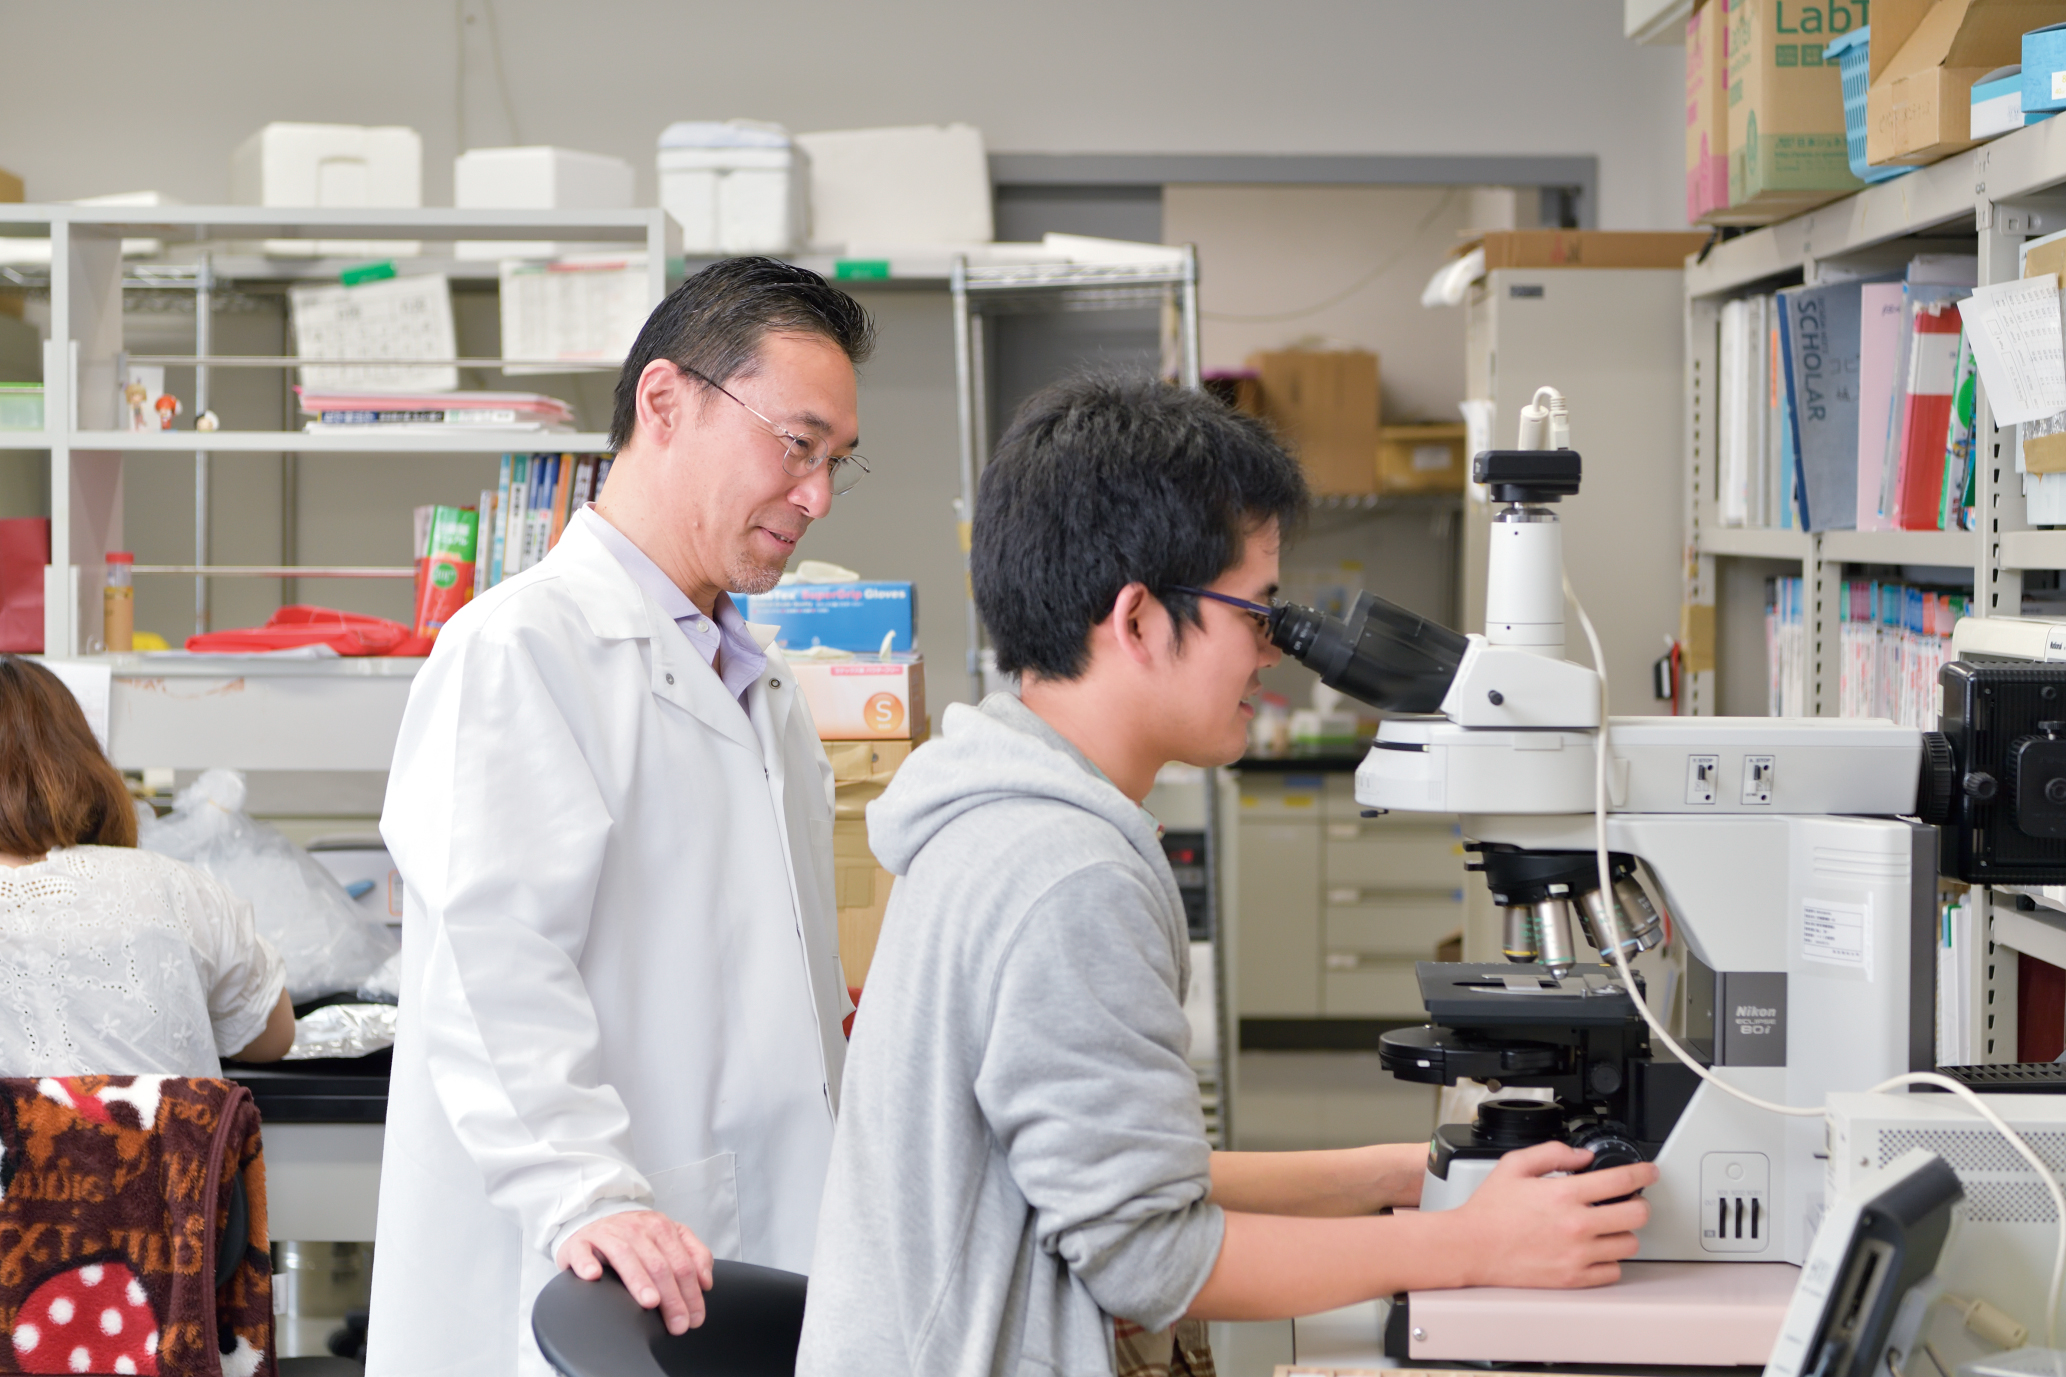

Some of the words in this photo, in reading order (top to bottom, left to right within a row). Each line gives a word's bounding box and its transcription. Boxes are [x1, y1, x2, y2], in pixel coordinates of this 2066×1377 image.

[1798, 300, 1826, 421] SCHOLAR
[801, 588, 862, 601] SuperGrip
[864, 588, 907, 600] Gloves
[876, 701, 892, 722] S
[1735, 1006, 1777, 1017] Nikon
